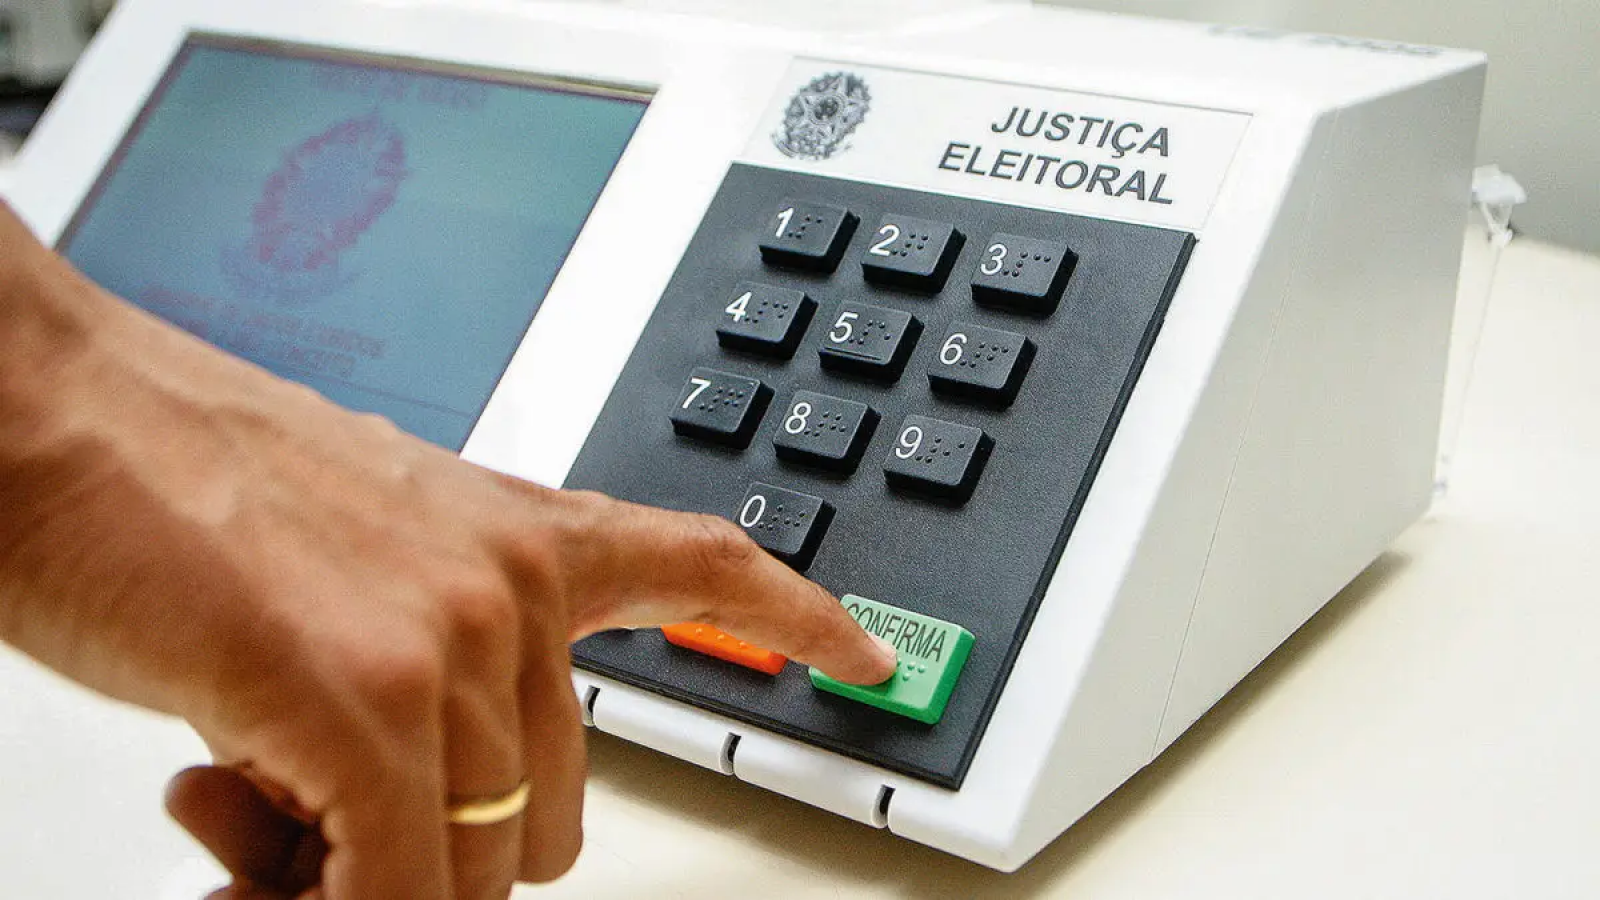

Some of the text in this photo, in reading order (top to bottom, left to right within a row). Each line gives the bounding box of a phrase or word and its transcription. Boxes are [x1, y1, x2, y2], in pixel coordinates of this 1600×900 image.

[991, 107, 1169, 159] JUSTIÇA
[937, 142, 1173, 206] ELEITORAL
[774, 207, 794, 239] 1
[869, 224, 900, 257] 2
[980, 243, 1008, 276] 3
[724, 291, 753, 323] 4
[829, 311, 859, 343] 5
[939, 332, 968, 365] 6
[682, 377, 712, 409] 7
[784, 401, 812, 435] 8
[895, 425, 923, 460] 9
[739, 494, 766, 528] 0
